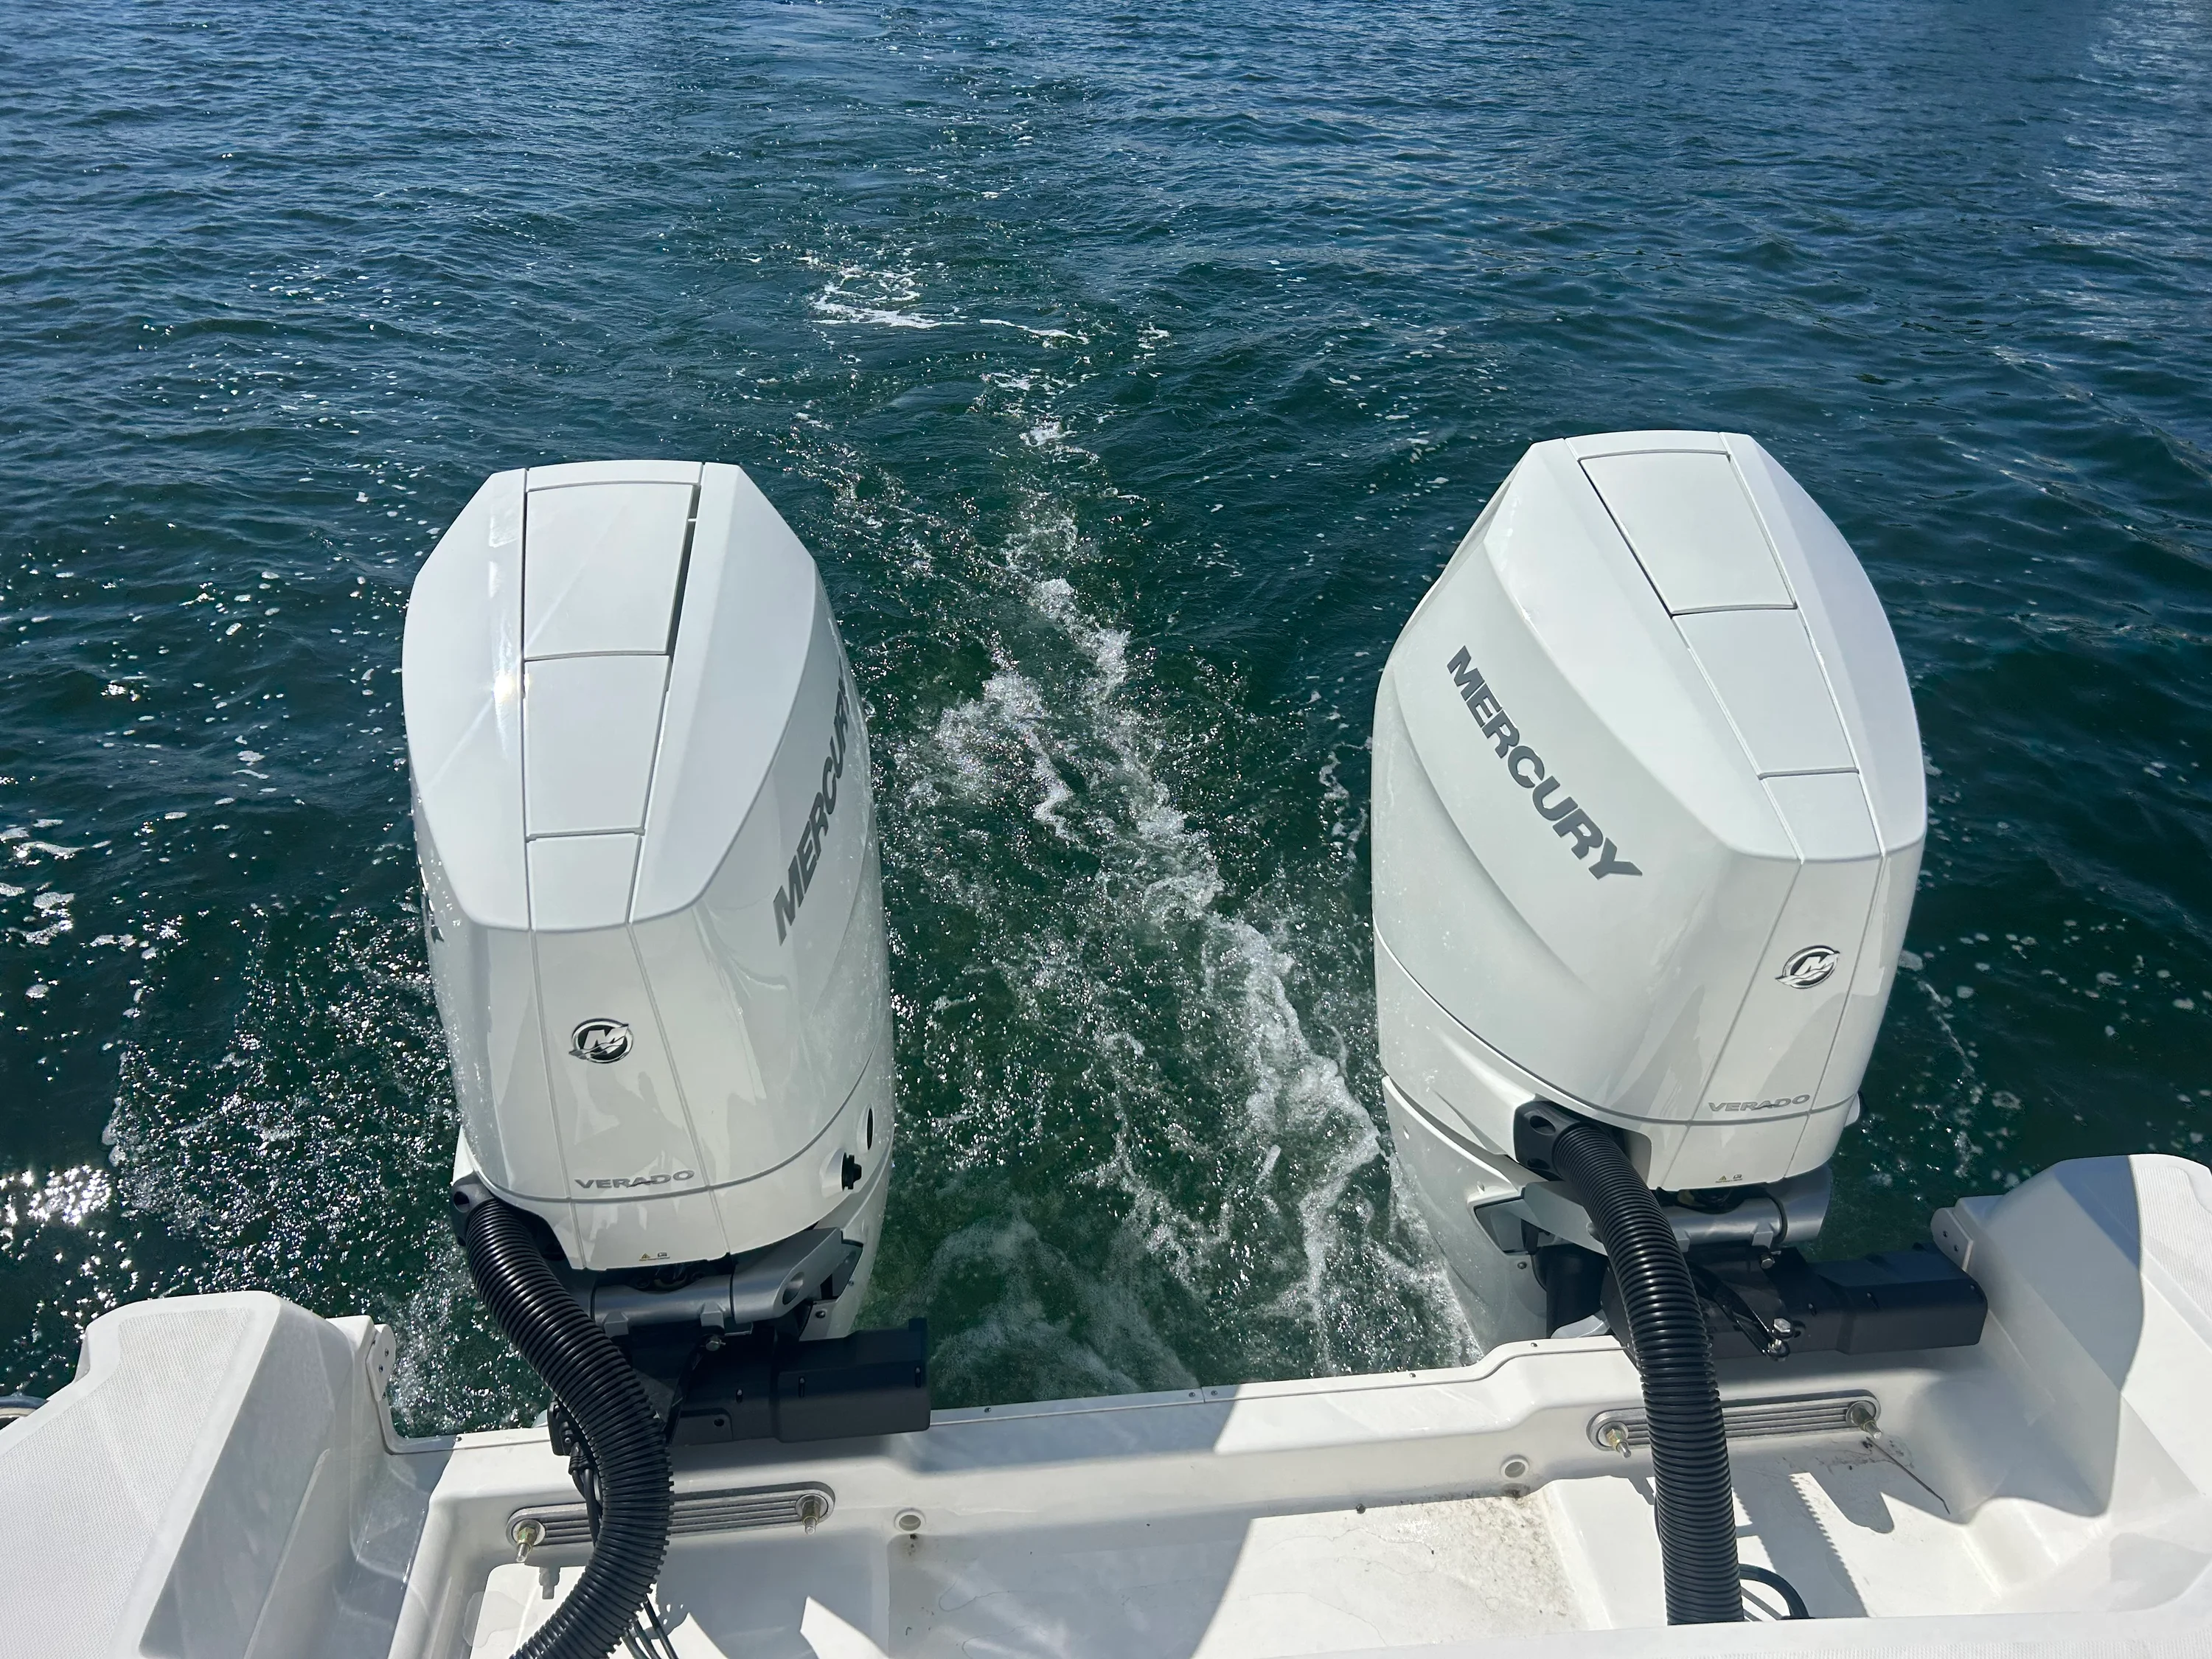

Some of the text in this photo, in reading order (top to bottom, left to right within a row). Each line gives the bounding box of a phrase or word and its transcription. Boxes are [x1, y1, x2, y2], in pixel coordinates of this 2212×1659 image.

[1446, 645, 1643, 880] MERCURY
[1708, 1094, 1811, 1112] VERADO
[574, 1169, 695, 1189] VERADO
